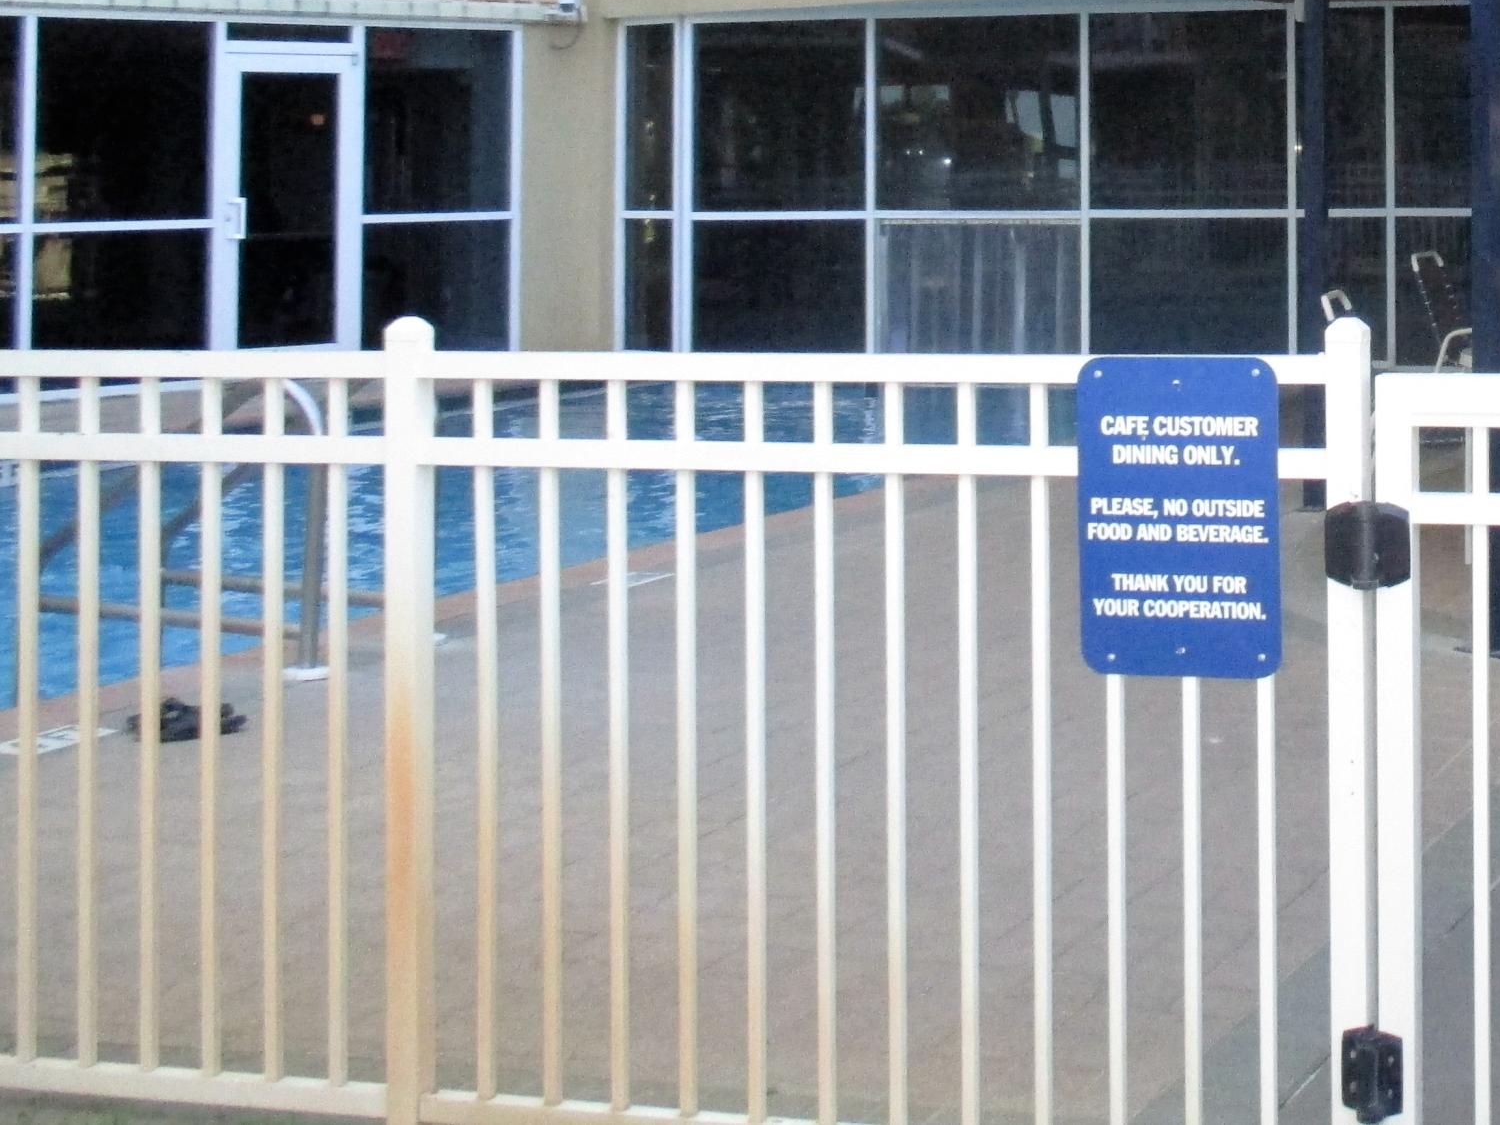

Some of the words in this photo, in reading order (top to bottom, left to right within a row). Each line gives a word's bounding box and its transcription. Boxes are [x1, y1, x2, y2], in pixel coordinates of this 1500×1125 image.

[1100, 415, 1150, 437] CAFE
[1152, 415, 1258, 437] CUSTOMER
[1112, 444, 1178, 465] DINING
[1183, 445, 1240, 465] ONLY.
[1090, 497, 1159, 519] PLEASE,
[1163, 498, 1188, 517] NO
[1192, 499, 1265, 518] OUTSIDE
[1087, 522, 1132, 541] FOOD
[1136, 523, 1172, 542] AND
[1176, 524, 1269, 543] BEVERAGE.
[1111, 573, 1168, 593] THANK
[1172, 574, 1208, 593] YOU
[1212, 575, 1247, 595] FOR
[1092, 597, 1140, 617] YOUR
[1143, 599, 1266, 620] COOPERATION.
